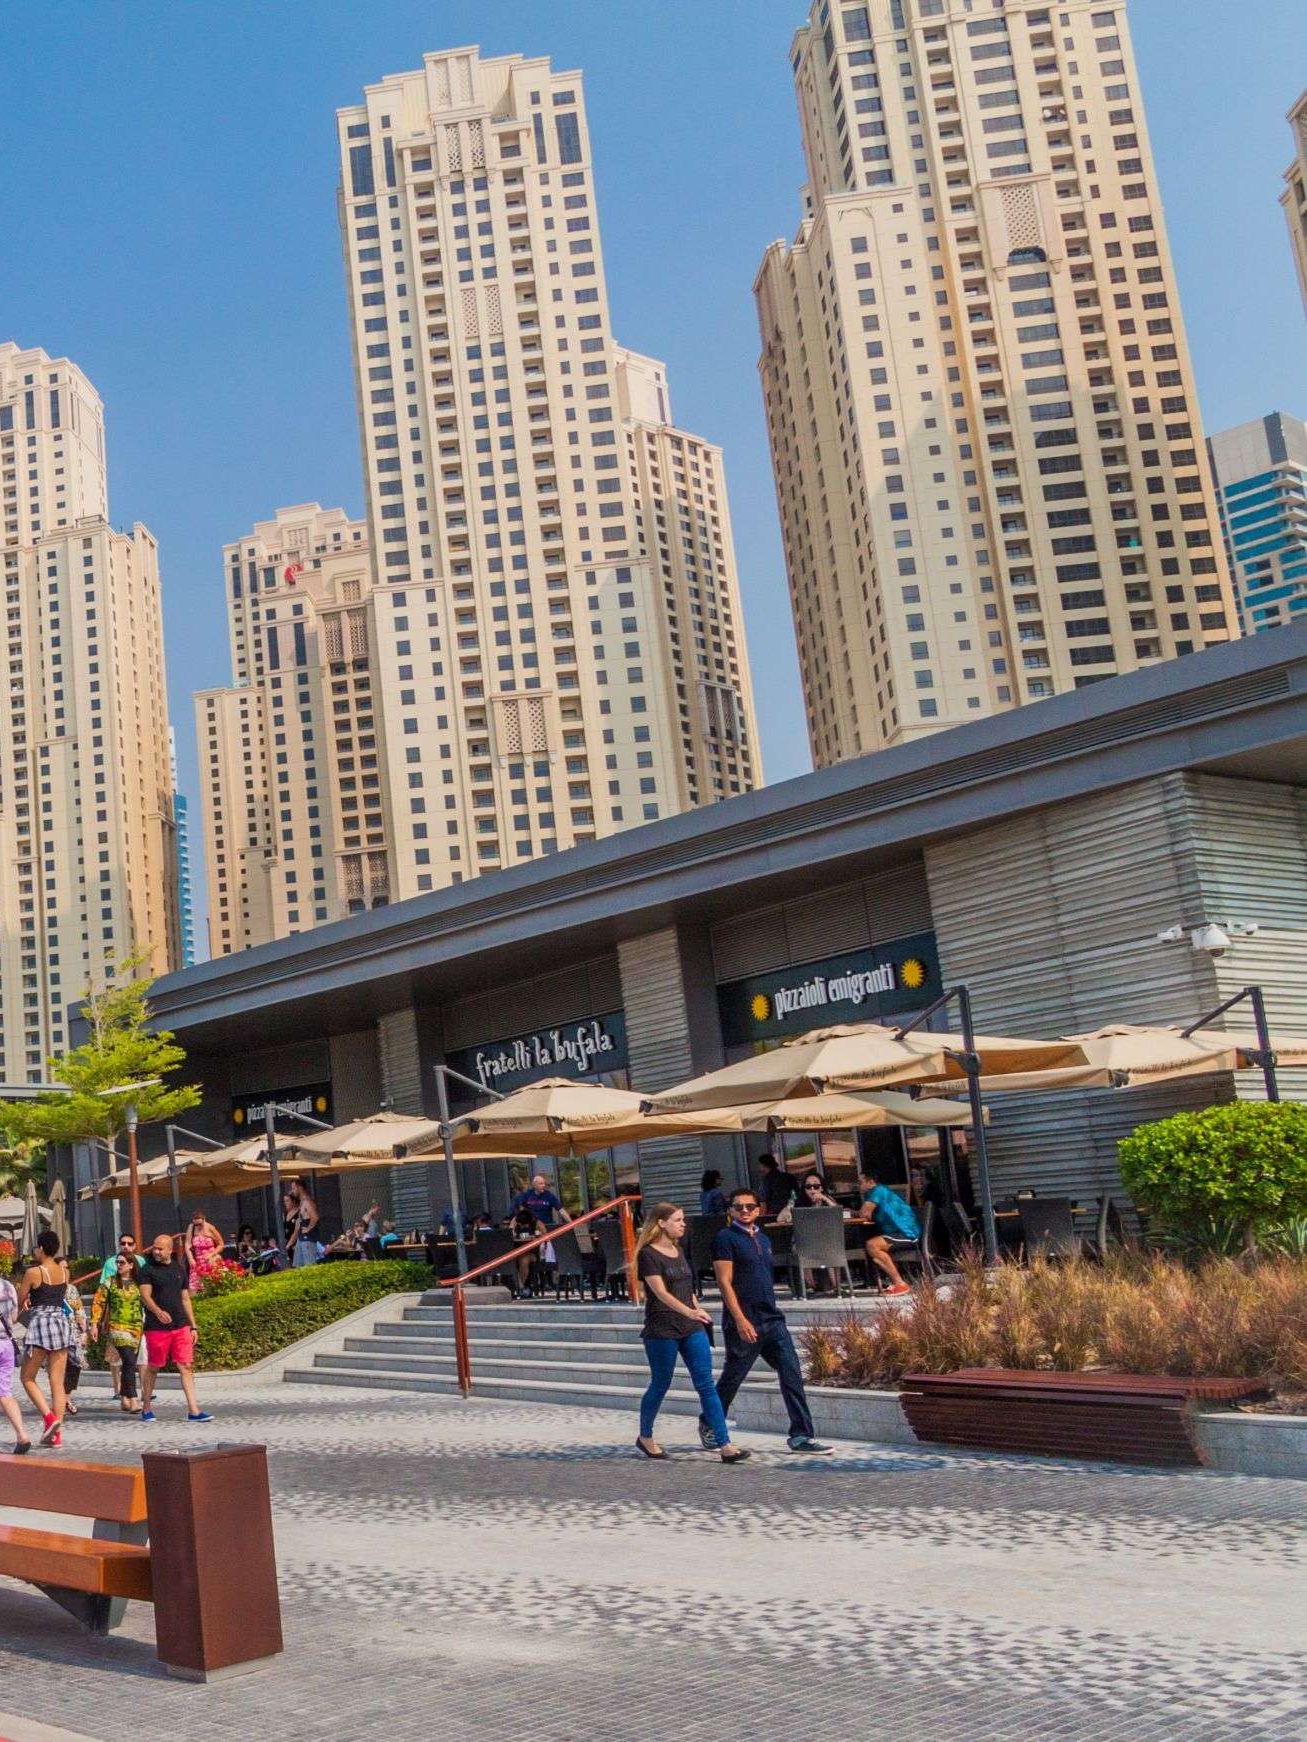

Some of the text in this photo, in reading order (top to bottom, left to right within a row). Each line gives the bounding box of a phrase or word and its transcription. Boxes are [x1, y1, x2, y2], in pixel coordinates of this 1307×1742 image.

[774, 963, 896, 1020] pizzaioli emigranti
[476, 1021, 614, 1087] fratelli la bufala
